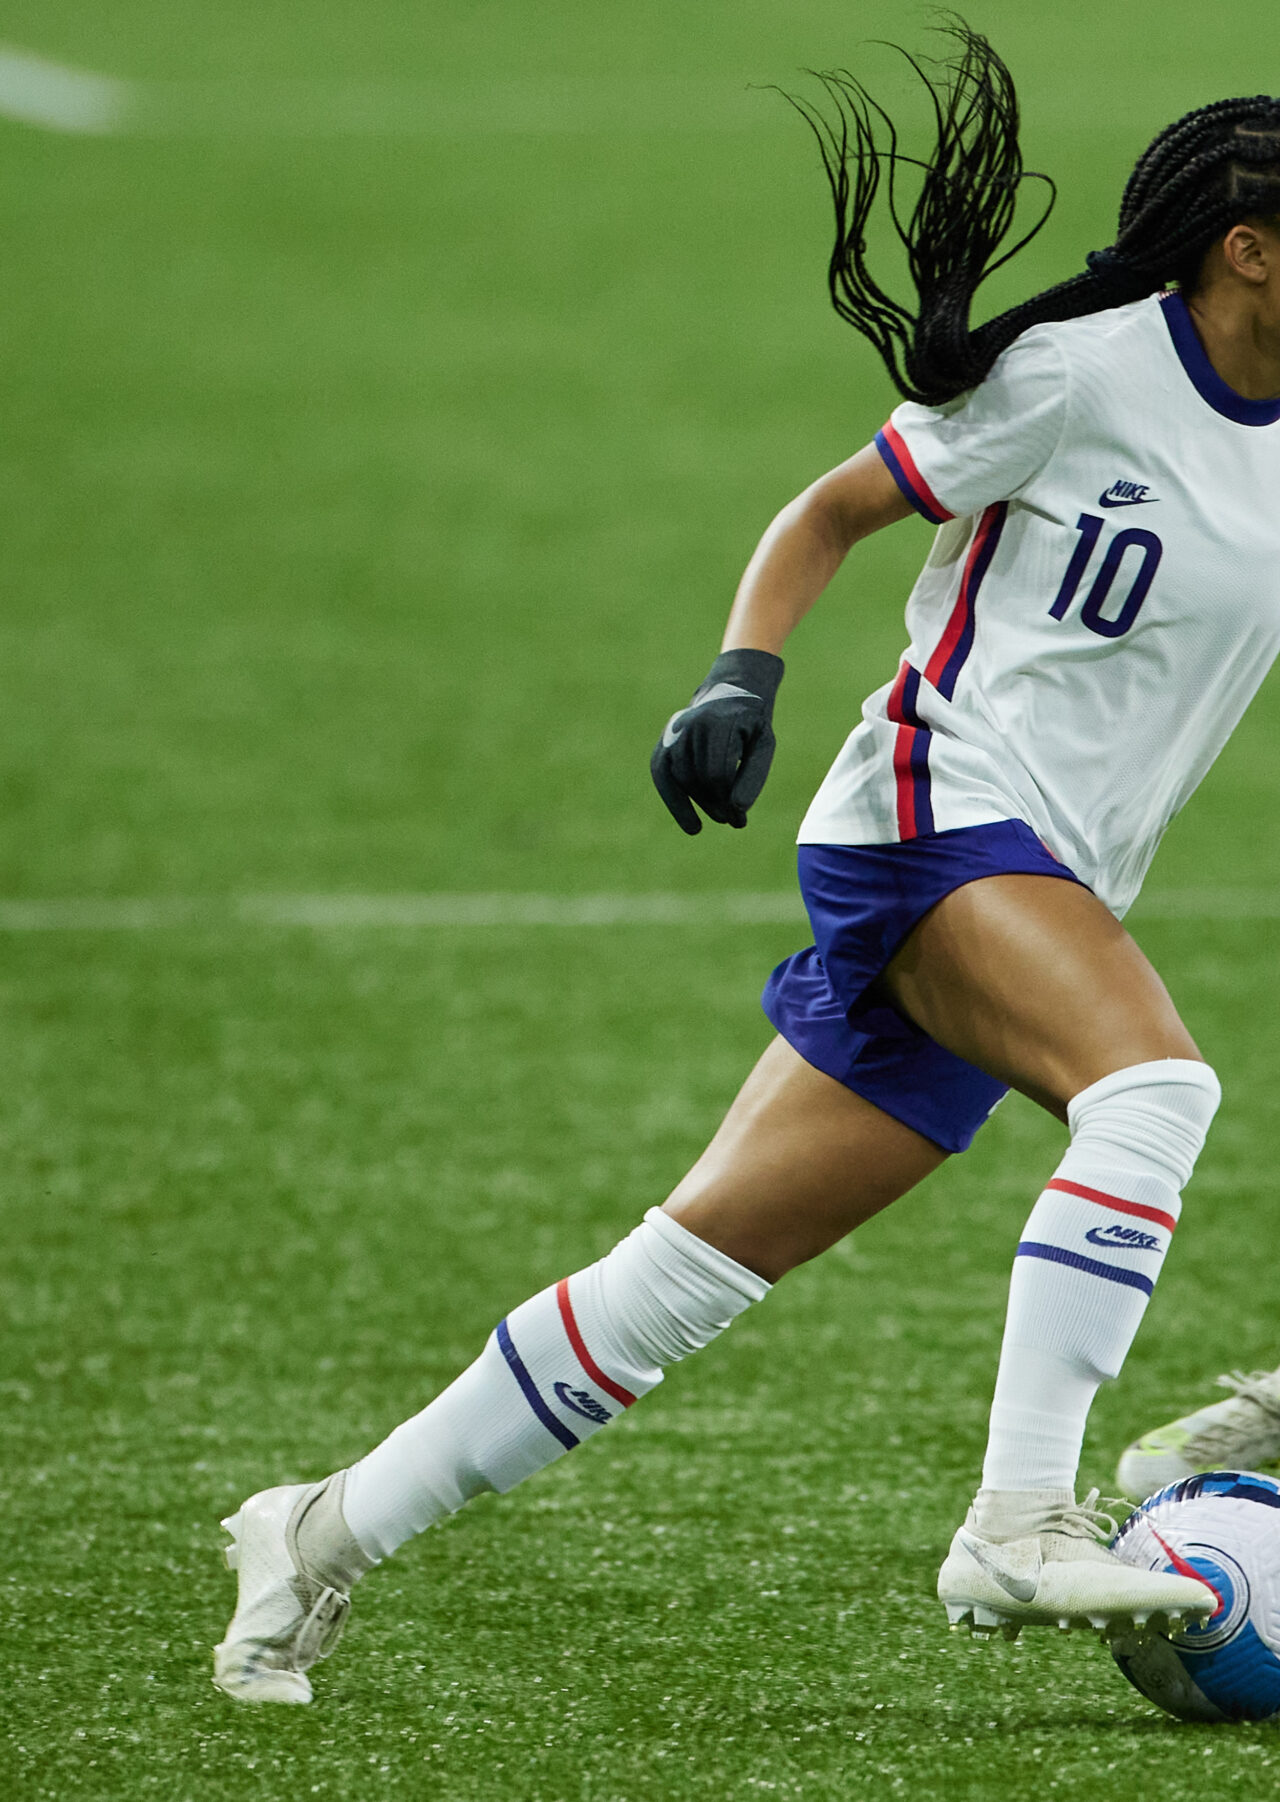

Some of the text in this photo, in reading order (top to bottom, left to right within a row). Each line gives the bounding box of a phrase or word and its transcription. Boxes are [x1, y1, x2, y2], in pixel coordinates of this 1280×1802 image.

[1109, 479, 1150, 501] NIKE
[1048, 512, 1163, 638] 10
[1103, 1225, 1161, 1248] NIKE
